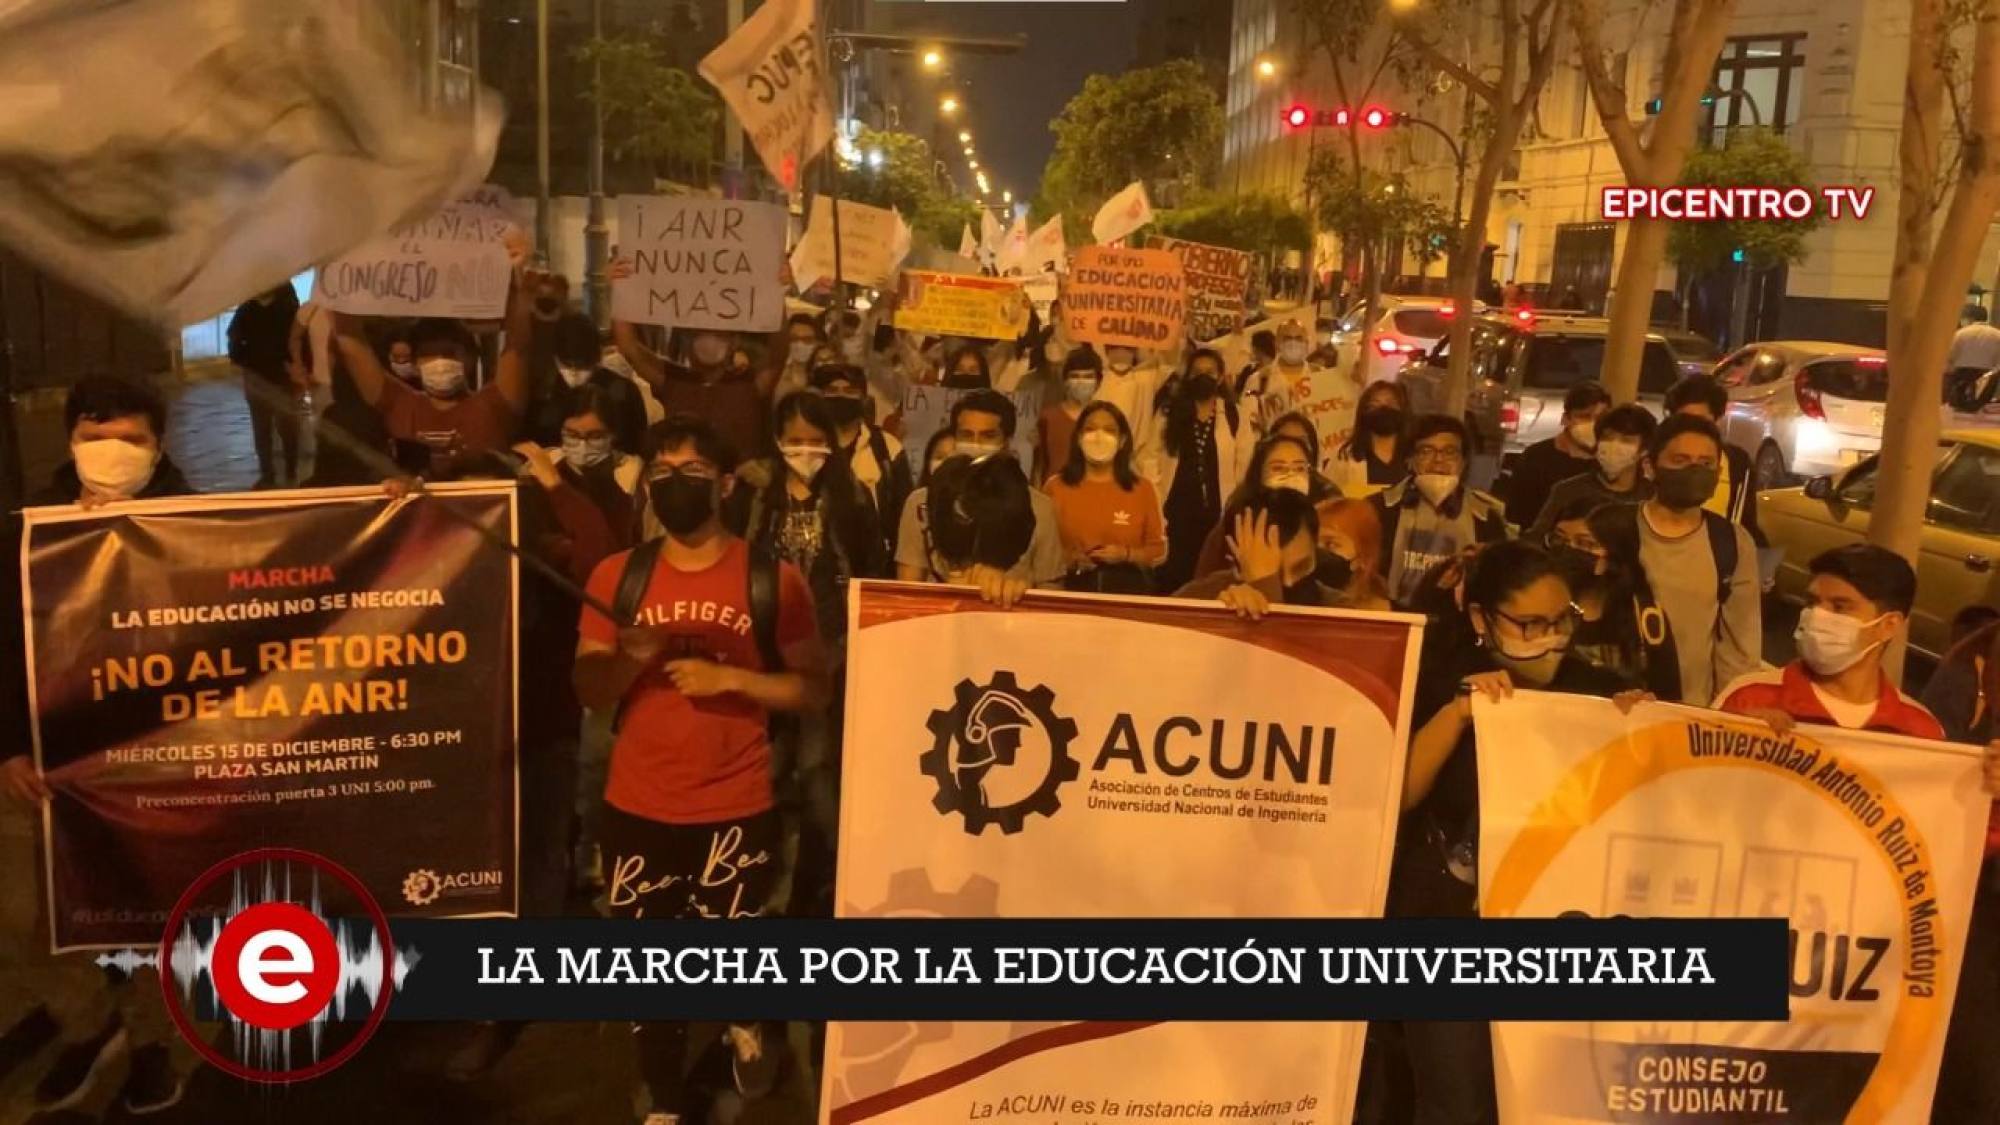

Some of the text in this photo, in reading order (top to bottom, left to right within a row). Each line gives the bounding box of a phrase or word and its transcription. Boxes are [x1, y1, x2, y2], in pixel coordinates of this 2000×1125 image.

[658, 207, 743, 242] ANR
[635, 249, 752, 275] NUNCA
[319, 260, 438, 303] CONGRESO
[1066, 292, 1183, 321] UNIVERSITARIA
[1072, 316, 1087, 330] DE
[229, 565, 336, 590] MARCHA
[112, 588, 445, 629] LA EDUCACIÓN NO SE NEGOCIA
[91, 630, 468, 701] ¡NO AL RETORNO
[162, 678, 408, 722] DE LA ANR!
[105, 744, 216, 763] MIÉRCOLES
[221, 743, 238, 759] 15
[243, 743, 268, 758] DE
[272, 735, 376, 757] DICIEMBRE
[390, 731, 429, 748] 6:30
[433, 729, 462, 746] PM
[1090, 712, 1337, 786] ACUNI
[194, 751, 379, 780] PLAZA SAN MARTÍN
[136, 790, 271, 808] Preconcentración
[275, 786, 325, 805] puerta
[328, 785, 337, 797] 3
[341, 782, 370, 796] UNI
[374, 779, 406, 793] 5:00
[1089, 777, 1329, 805] Asociación de Centros de Estudiantes
[1087, 796, 1170, 813] Universidad
[1174, 802, 1233, 816] Nacional
[1237, 804, 1254, 818] de
[1688, 723, 1941, 998] Universidad Antonio Ruiz de Montoya
[443, 871, 503, 888] ACUNI
[1789, 928, 1892, 1001] UIZ
[1638, 1056, 1767, 1084] CONSEJO
[969, 1094, 1318, 1119] La ACUNI es la instancia máxima de
[1607, 1085, 1789, 1114] ESTUDIANTIL
